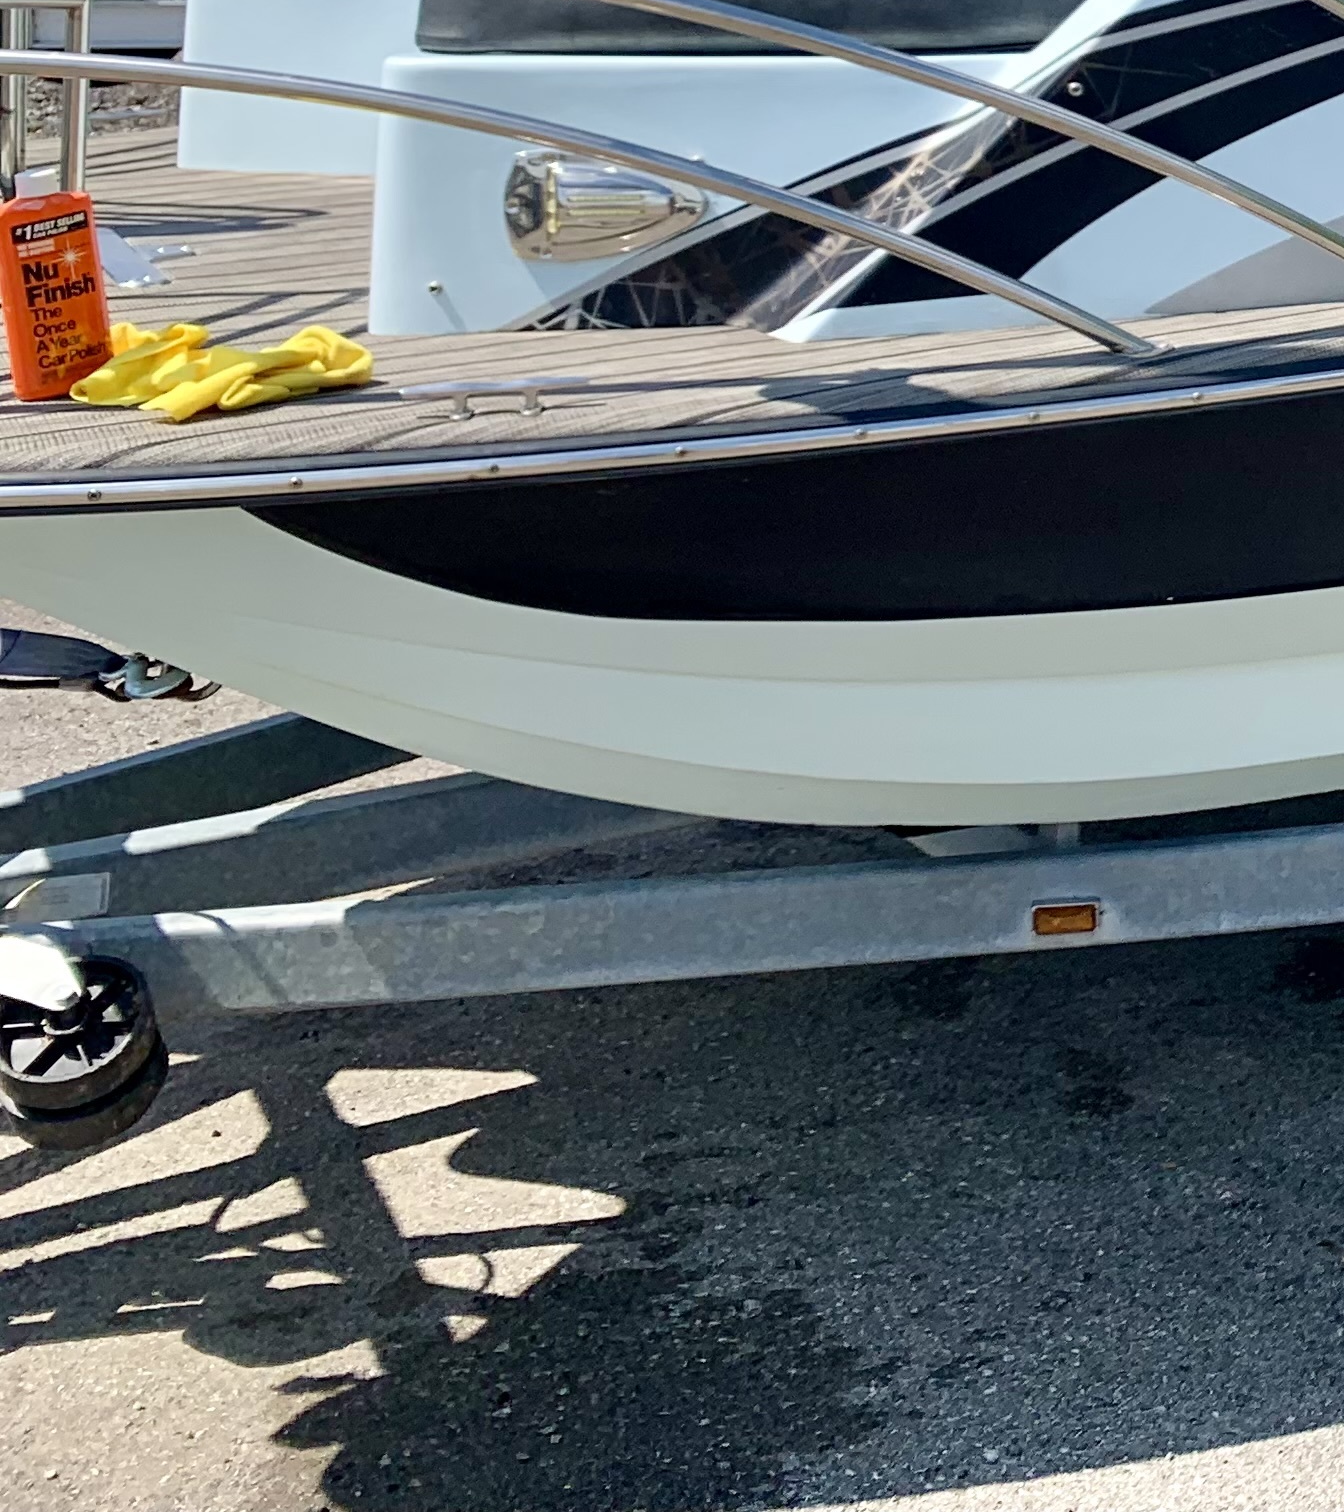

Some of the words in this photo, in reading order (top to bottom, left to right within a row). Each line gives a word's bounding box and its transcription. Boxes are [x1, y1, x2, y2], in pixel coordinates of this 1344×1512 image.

[22, 261, 58, 285] Nu
[27, 274, 96, 307] Finish
[31, 306, 63, 322] The
[33, 319, 76, 338] Once
[37, 341, 49, 354] A
[50, 332, 82, 349] Year
[39, 353, 68, 369] Car
[69, 341, 106, 362] Polish
